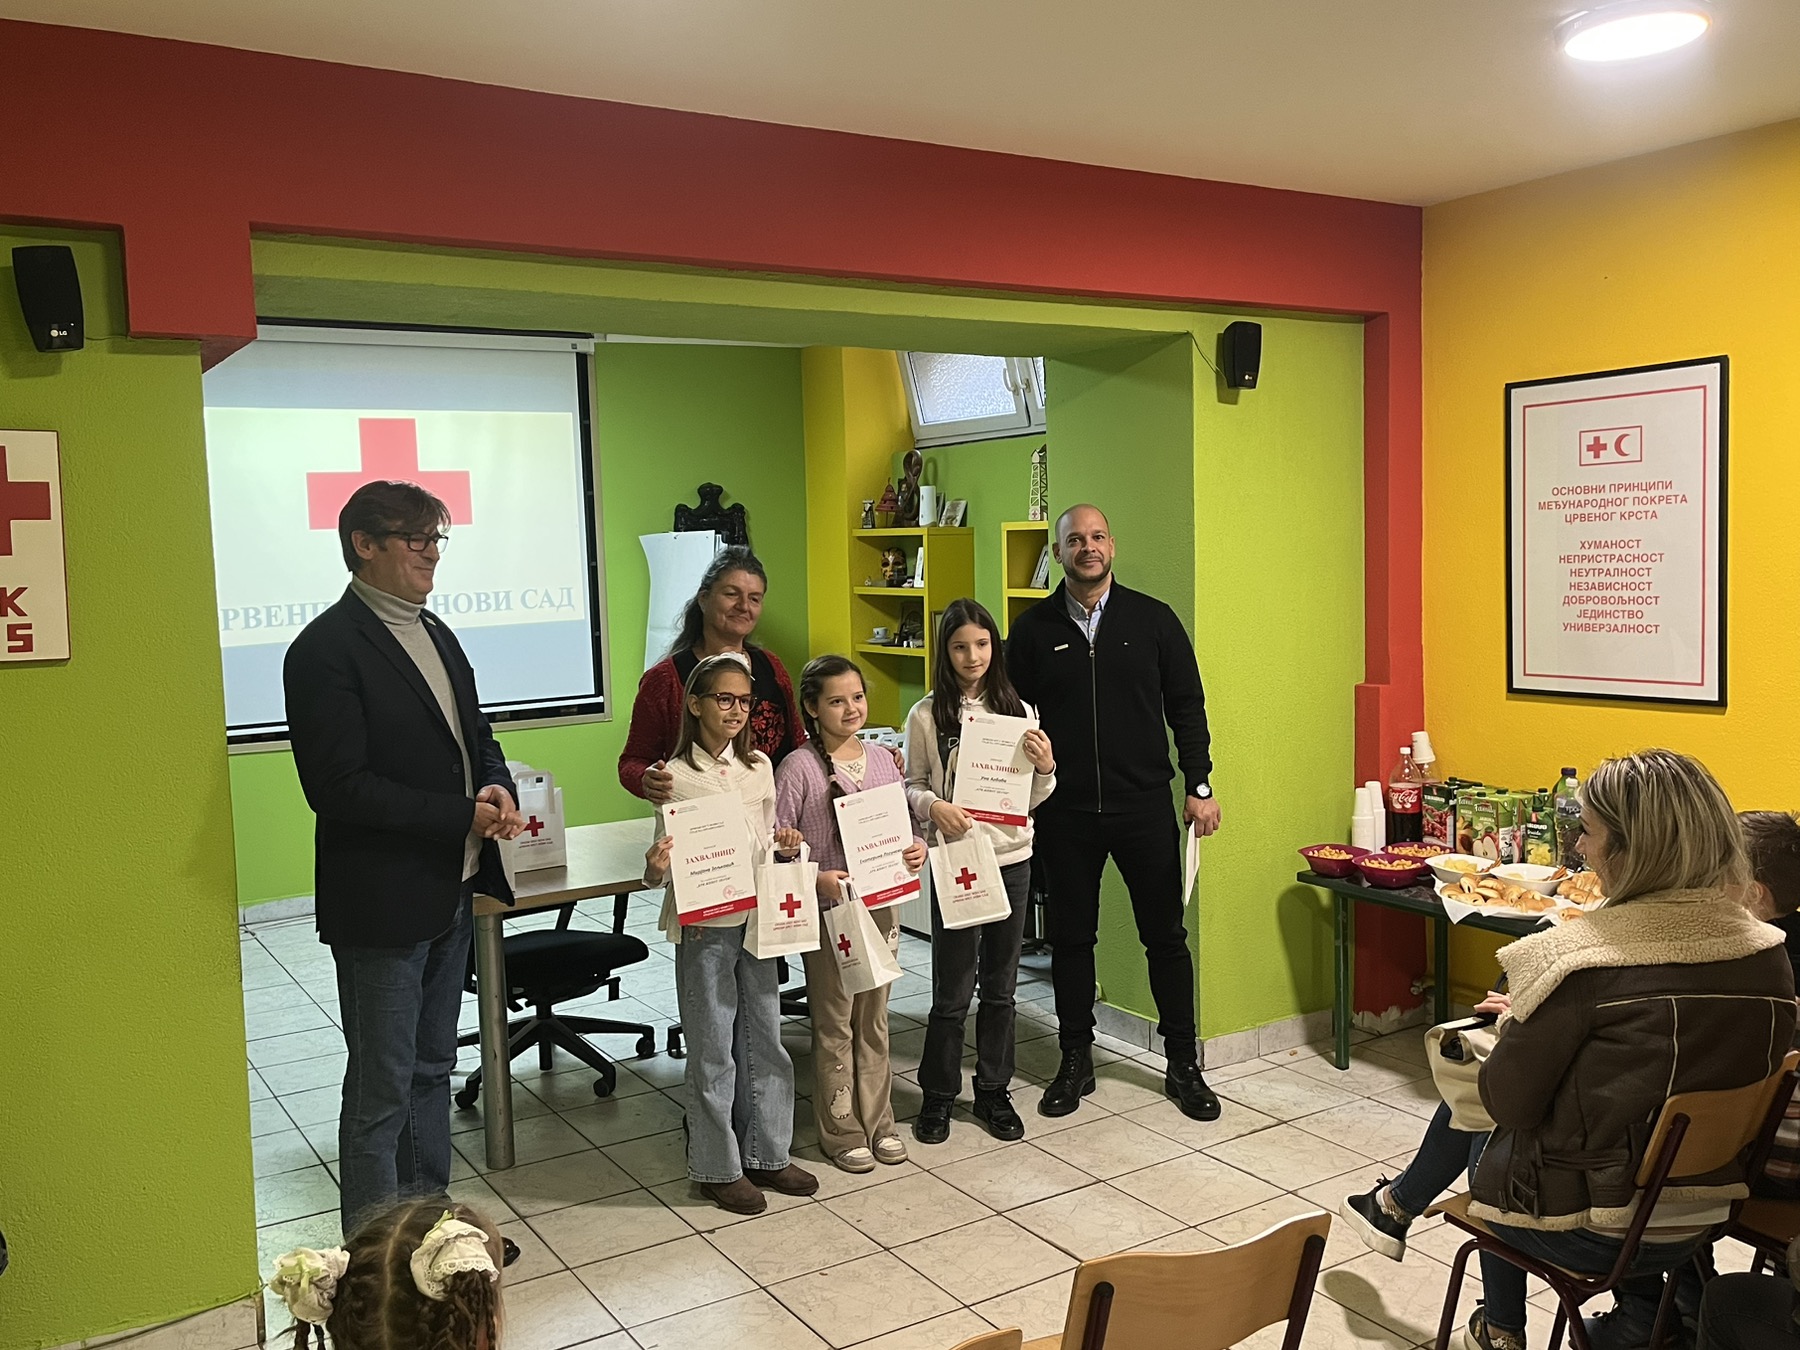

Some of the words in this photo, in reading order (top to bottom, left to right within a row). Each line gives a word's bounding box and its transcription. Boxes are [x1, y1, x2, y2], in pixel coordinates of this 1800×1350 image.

[1551, 484, 1606, 497] ОСНОВНИ
[1609, 480, 1673, 494] ПРИНЦИПИ
[1538, 496, 1630, 511] МЕЂУНАРОДНОГ
[1632, 494, 1688, 506] ПОКРЕТА
[1564, 511, 1617, 525] ЦРВЕНОГ
[1619, 510, 1658, 522] КРСТА
[1579, 539, 1642, 550] ХУМАНОСТ
[1558, 552, 1665, 564] НЕПРИСТРАСНОСТ
[1569, 567, 1653, 578] НЕУТРАЛНОСТ
[1569, 581, 1653, 592] НЕЗАВИСНОСТ
[0, 586, 28, 617] K
[1562, 595, 1660, 607] ДОБРОВОЉНОСТ
[220, 600, 333, 631] РВЕН
[430, 589, 514, 616] НОВИ
[520, 587, 576, 613] САД
[1576, 608, 1644, 620] ЈЕДИНСТВО
[1562, 622, 1661, 634] УНИВЕРЗАЛНОСТ
[6, 623, 33, 653] S
[685, 847, 736, 864] ЗАХВАЛНИЦУ
